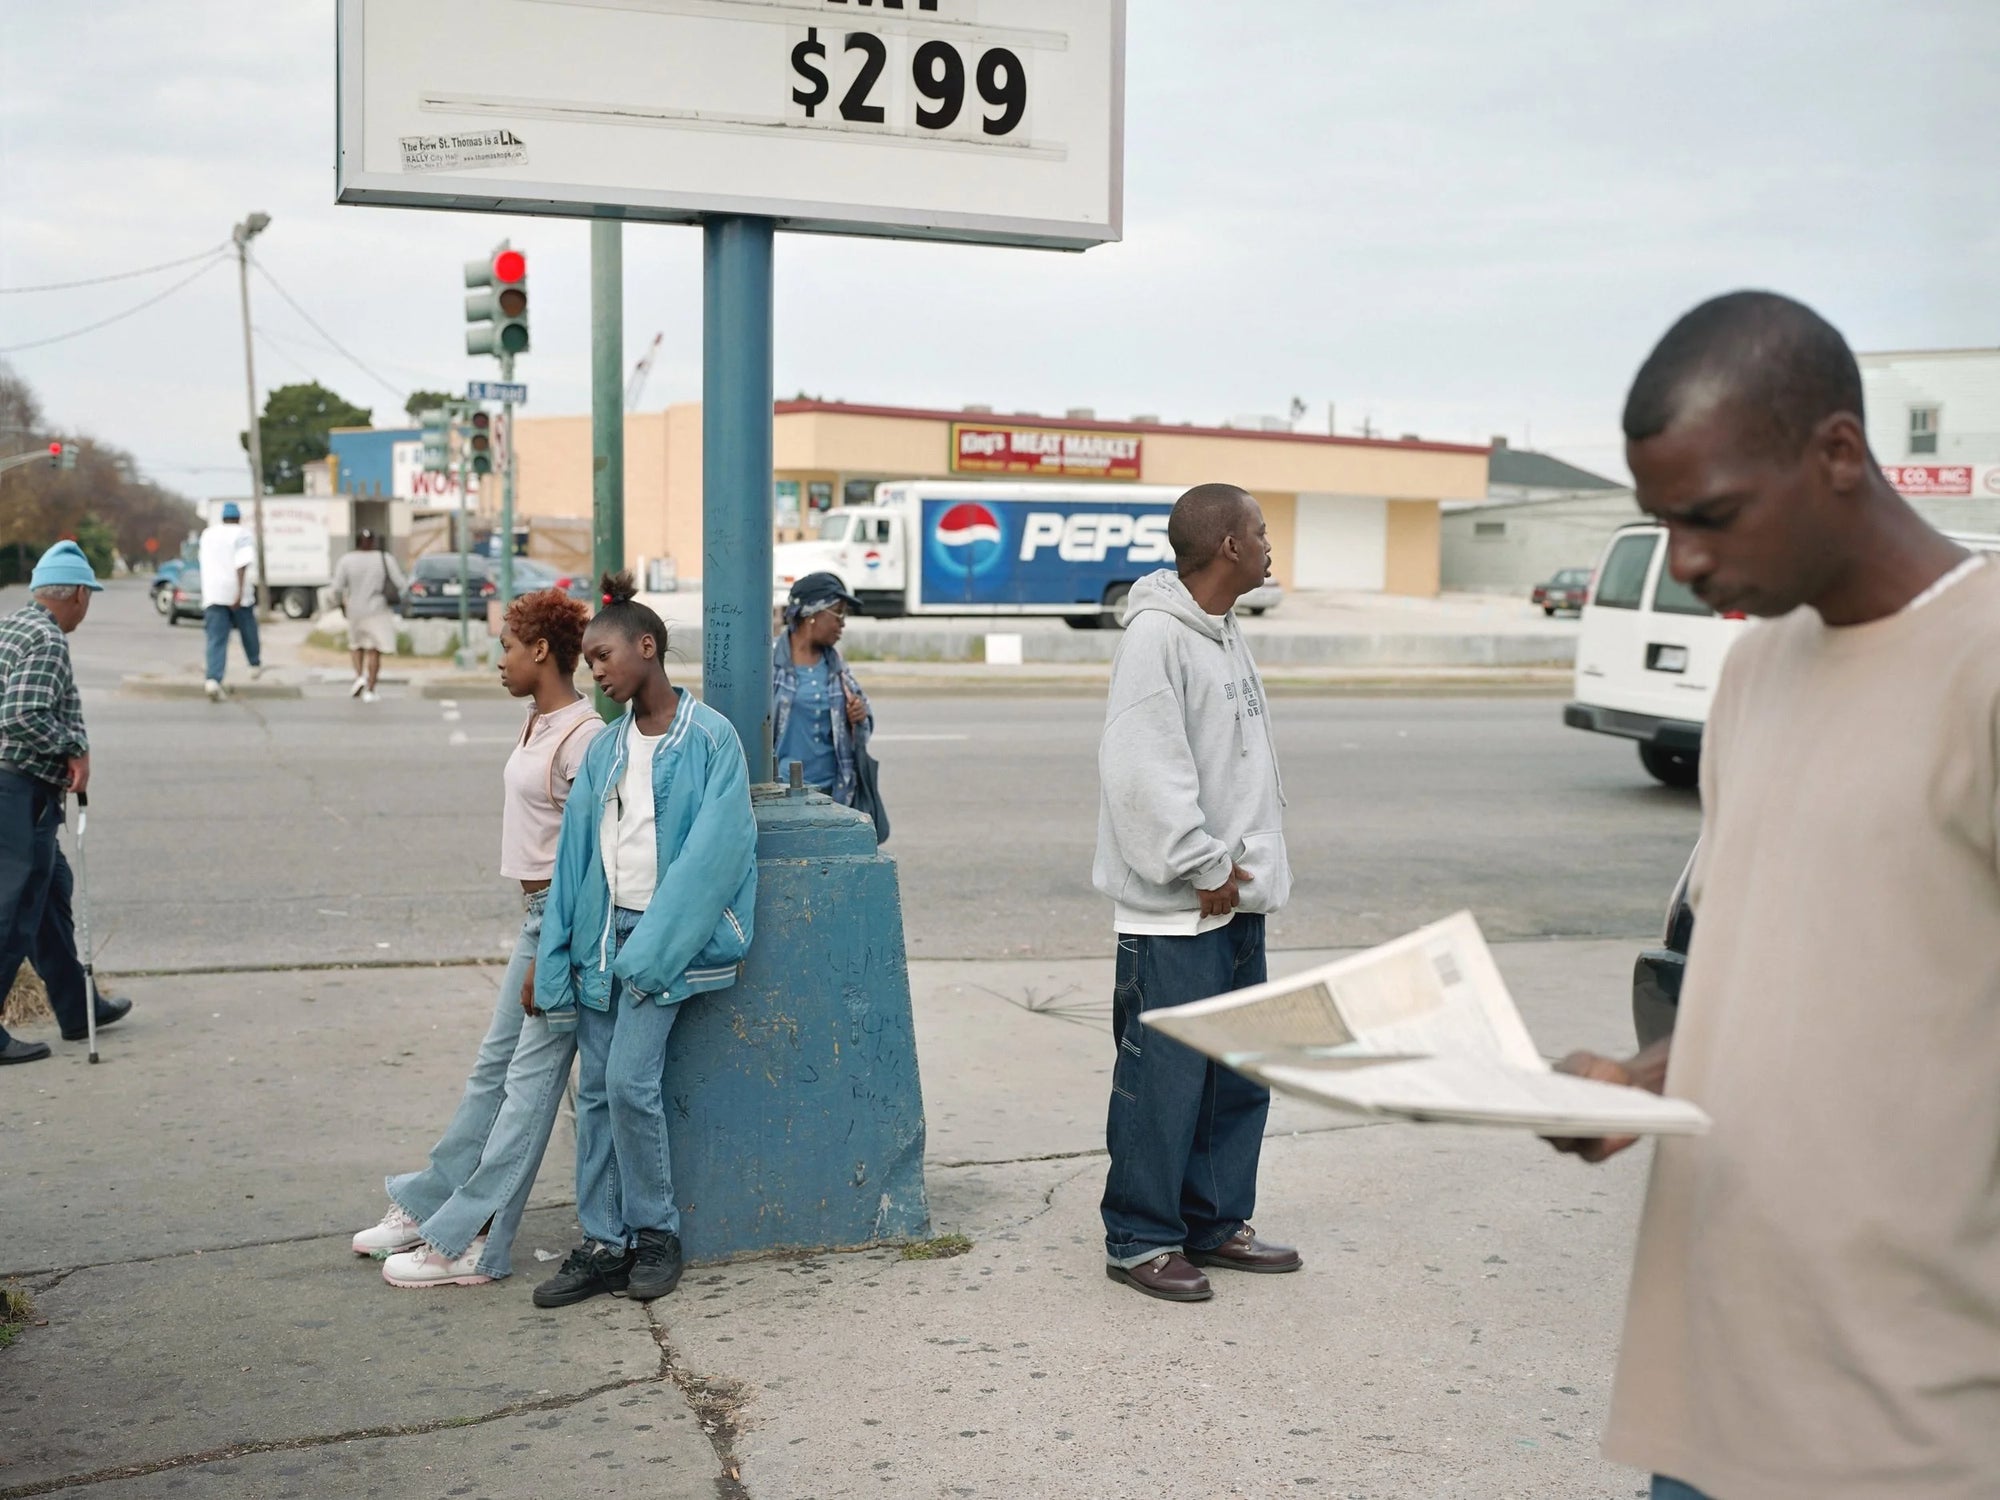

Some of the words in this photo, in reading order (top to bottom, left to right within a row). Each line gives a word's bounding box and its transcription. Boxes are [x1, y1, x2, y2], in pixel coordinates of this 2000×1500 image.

[402, 142, 417, 152] The
[438, 137, 450, 149] St.
[451, 136, 483, 149] Thomas
[484, 135, 492, 146] is
[493, 136, 499, 145] a
[406, 154, 429, 164] RALLY
[430, 153, 443, 162] City
[485, 384, 524, 401] Broad
[960, 431, 1006, 456] King's
[1010, 432, 1061, 454] MEAT
[1063, 436, 1138, 460] MARKET
[1018, 511, 1177, 563] PEPS
